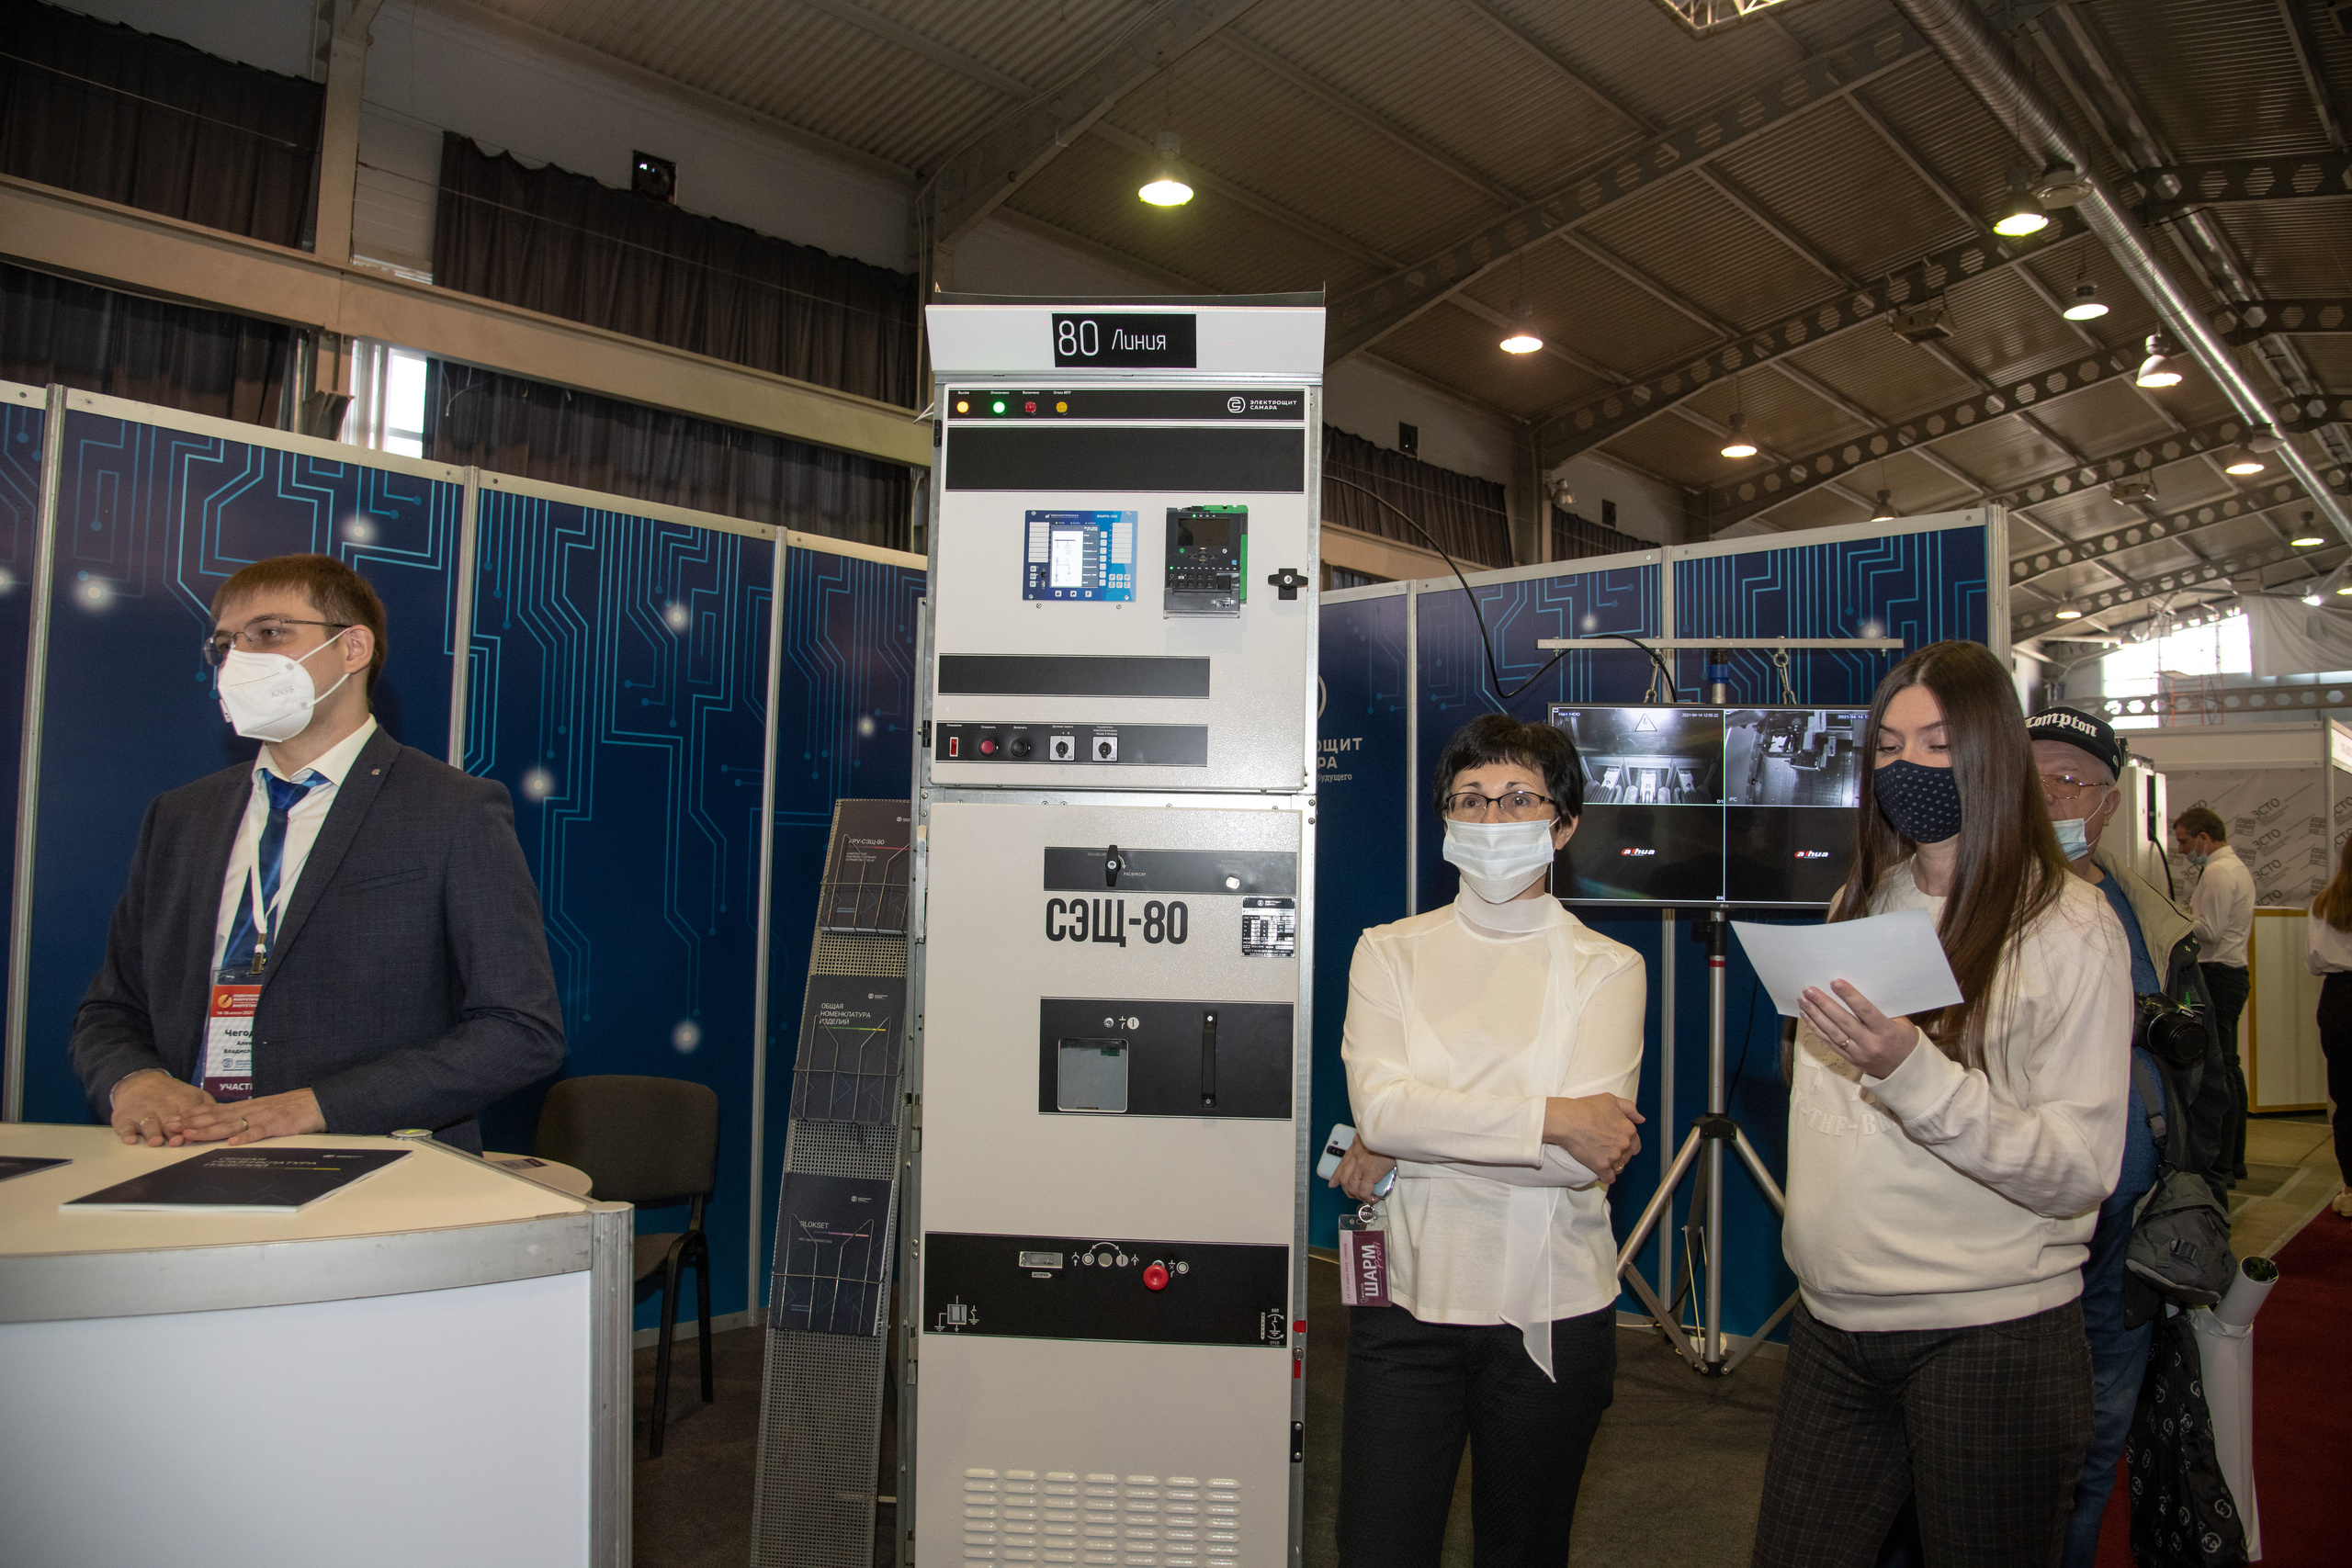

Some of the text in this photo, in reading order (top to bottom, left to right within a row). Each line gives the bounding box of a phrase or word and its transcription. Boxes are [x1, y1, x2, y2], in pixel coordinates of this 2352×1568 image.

[1058, 320, 1167, 356] 80 Линия
[2025, 713, 2098, 738] Compton
[1317, 773, 1352, 783] будущего
[848, 838, 886, 846] КРУ-СЭЩ-80
[1046, 898, 1188, 947] СЭЩ-80
[820, 1002, 844, 1010] ОБЩАЯ
[1372, 1241, 1384, 1269] Profi
[1361, 1245, 1379, 1297] ШАРМ
